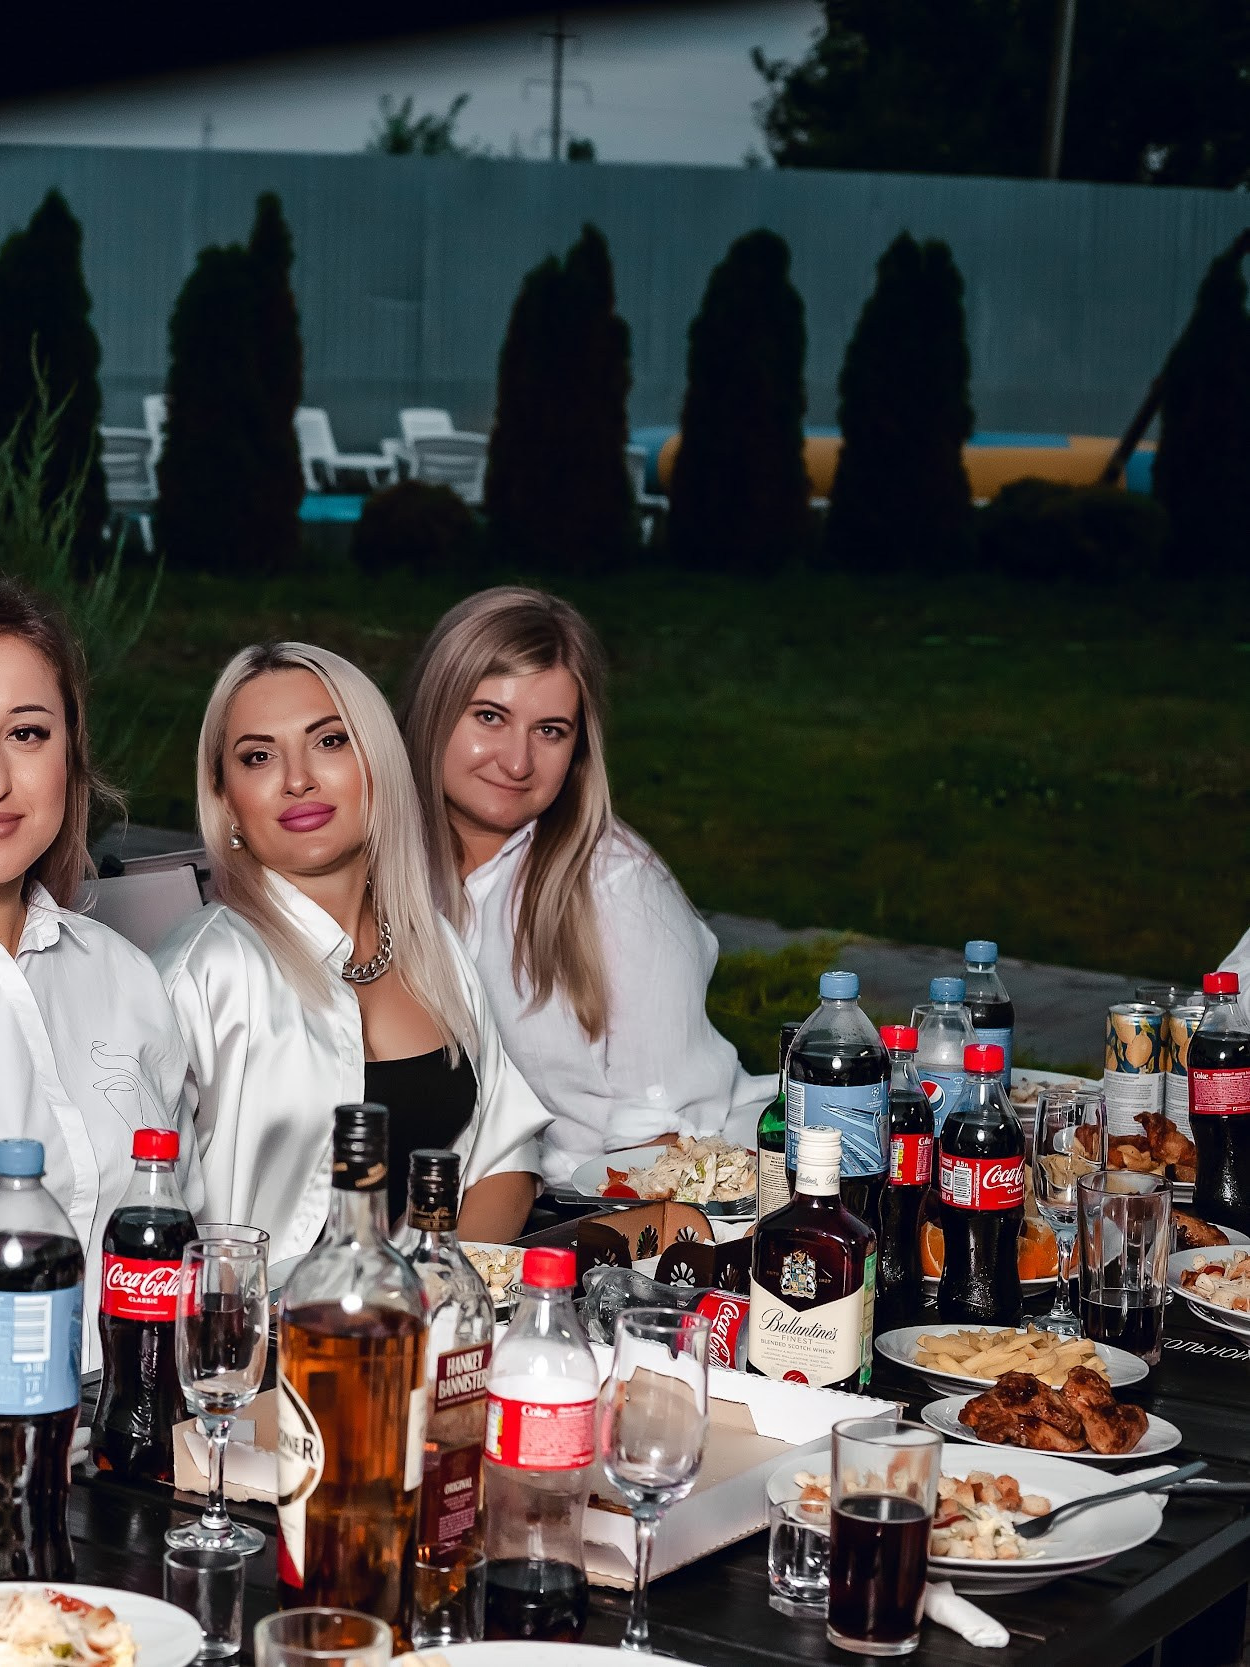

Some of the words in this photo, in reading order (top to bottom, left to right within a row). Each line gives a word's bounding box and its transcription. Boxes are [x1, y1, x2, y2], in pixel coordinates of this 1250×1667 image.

[128, 1296, 158, 1305] CLASSIC
[759, 1308, 838, 1341] Ballantine's
[760, 1338, 787, 1348] BLENDED
[788, 1343, 812, 1351] SCOTCH
[812, 1347, 836, 1355] WHISKY
[781, 1334, 814, 1345] FINEST
[446, 1349, 484, 1378] HANKEY
